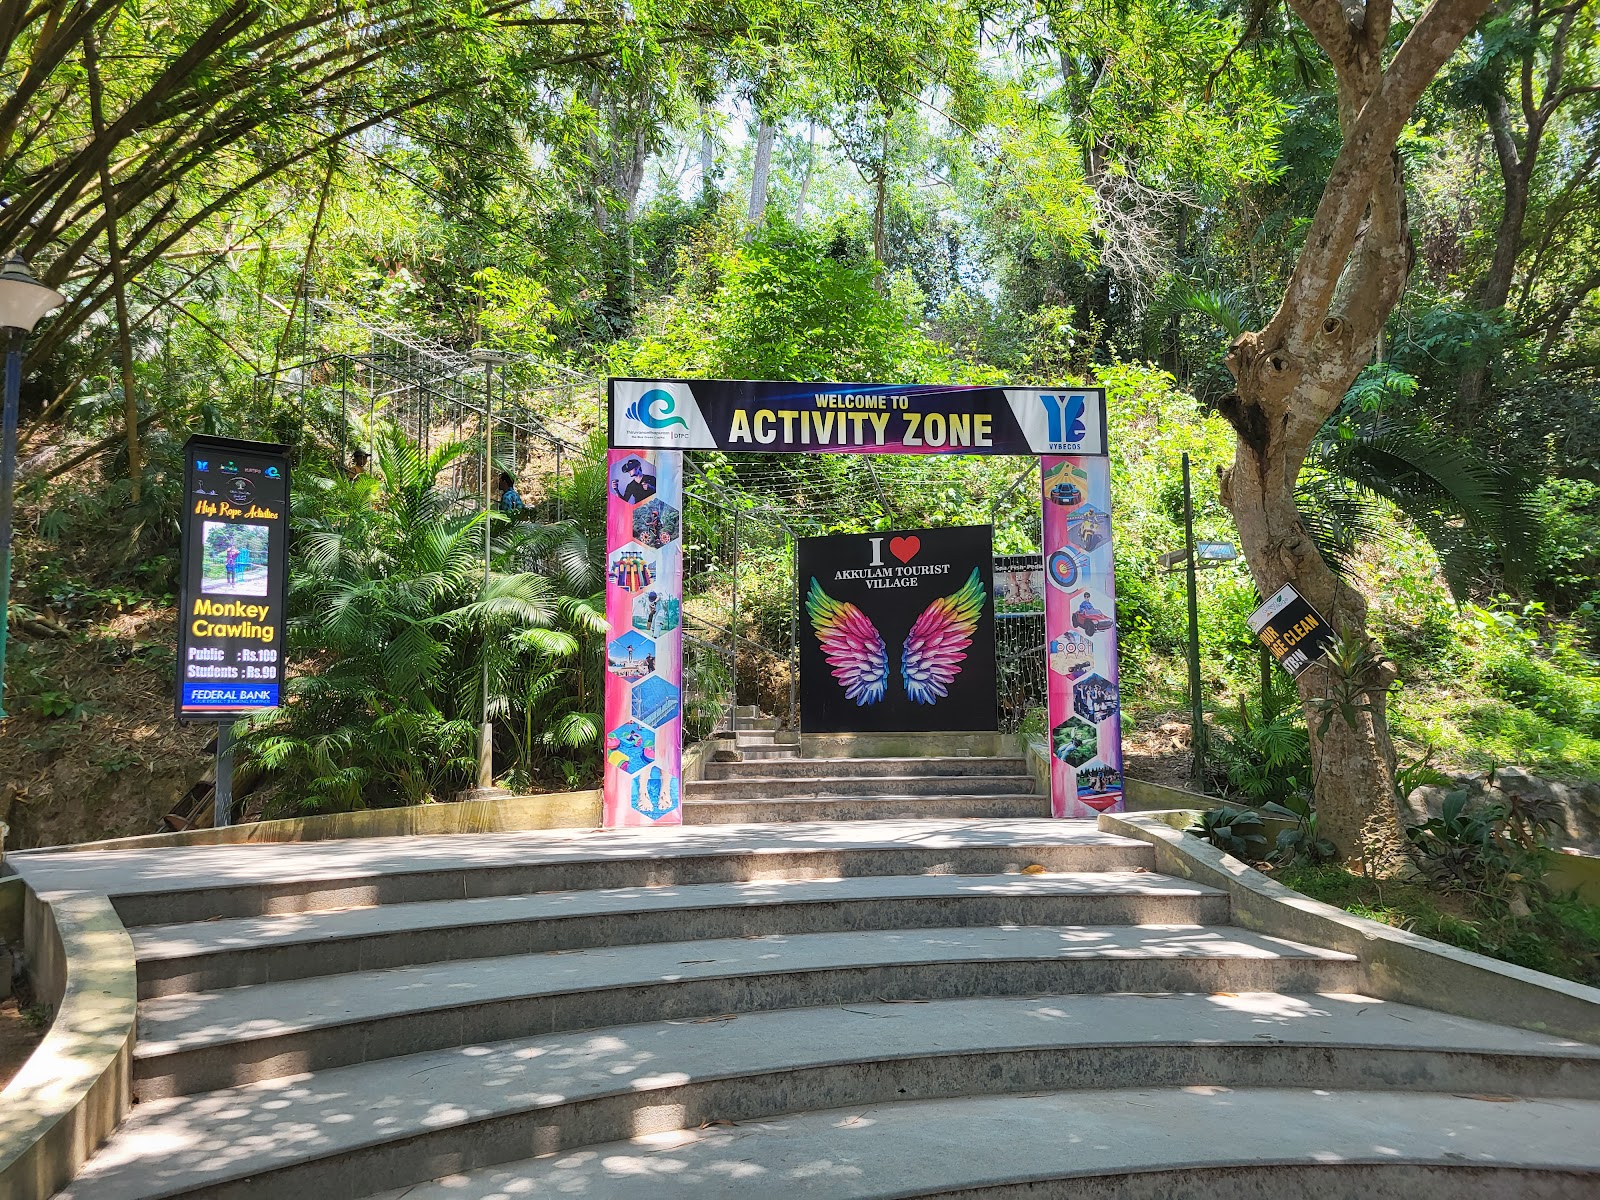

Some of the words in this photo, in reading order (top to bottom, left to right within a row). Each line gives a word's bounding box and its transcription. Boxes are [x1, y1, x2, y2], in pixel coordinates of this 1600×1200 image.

[815, 393, 886, 409] WELCOME
[890, 396, 909, 410] TO
[728, 409, 891, 446] ACTIVITY
[902, 412, 993, 447] ZONE
[194, 500, 217, 517] High
[218, 501, 242, 519] Rope
[244, 504, 279, 519] Activities
[868, 537, 885, 567] I
[834, 566, 894, 580] AKKULAM
[895, 563, 951, 577] TOURIST
[865, 576, 919, 590] VILLAGE
[193, 598, 270, 622] Monkey
[191, 619, 275, 643] Crawling
[1283, 613, 1320, 646] CLEAN
[188, 647, 225, 661] Public
[187, 664, 239, 678] Students
[191, 689, 238, 700] FEDERAL
[240, 690, 271, 700] BANK
